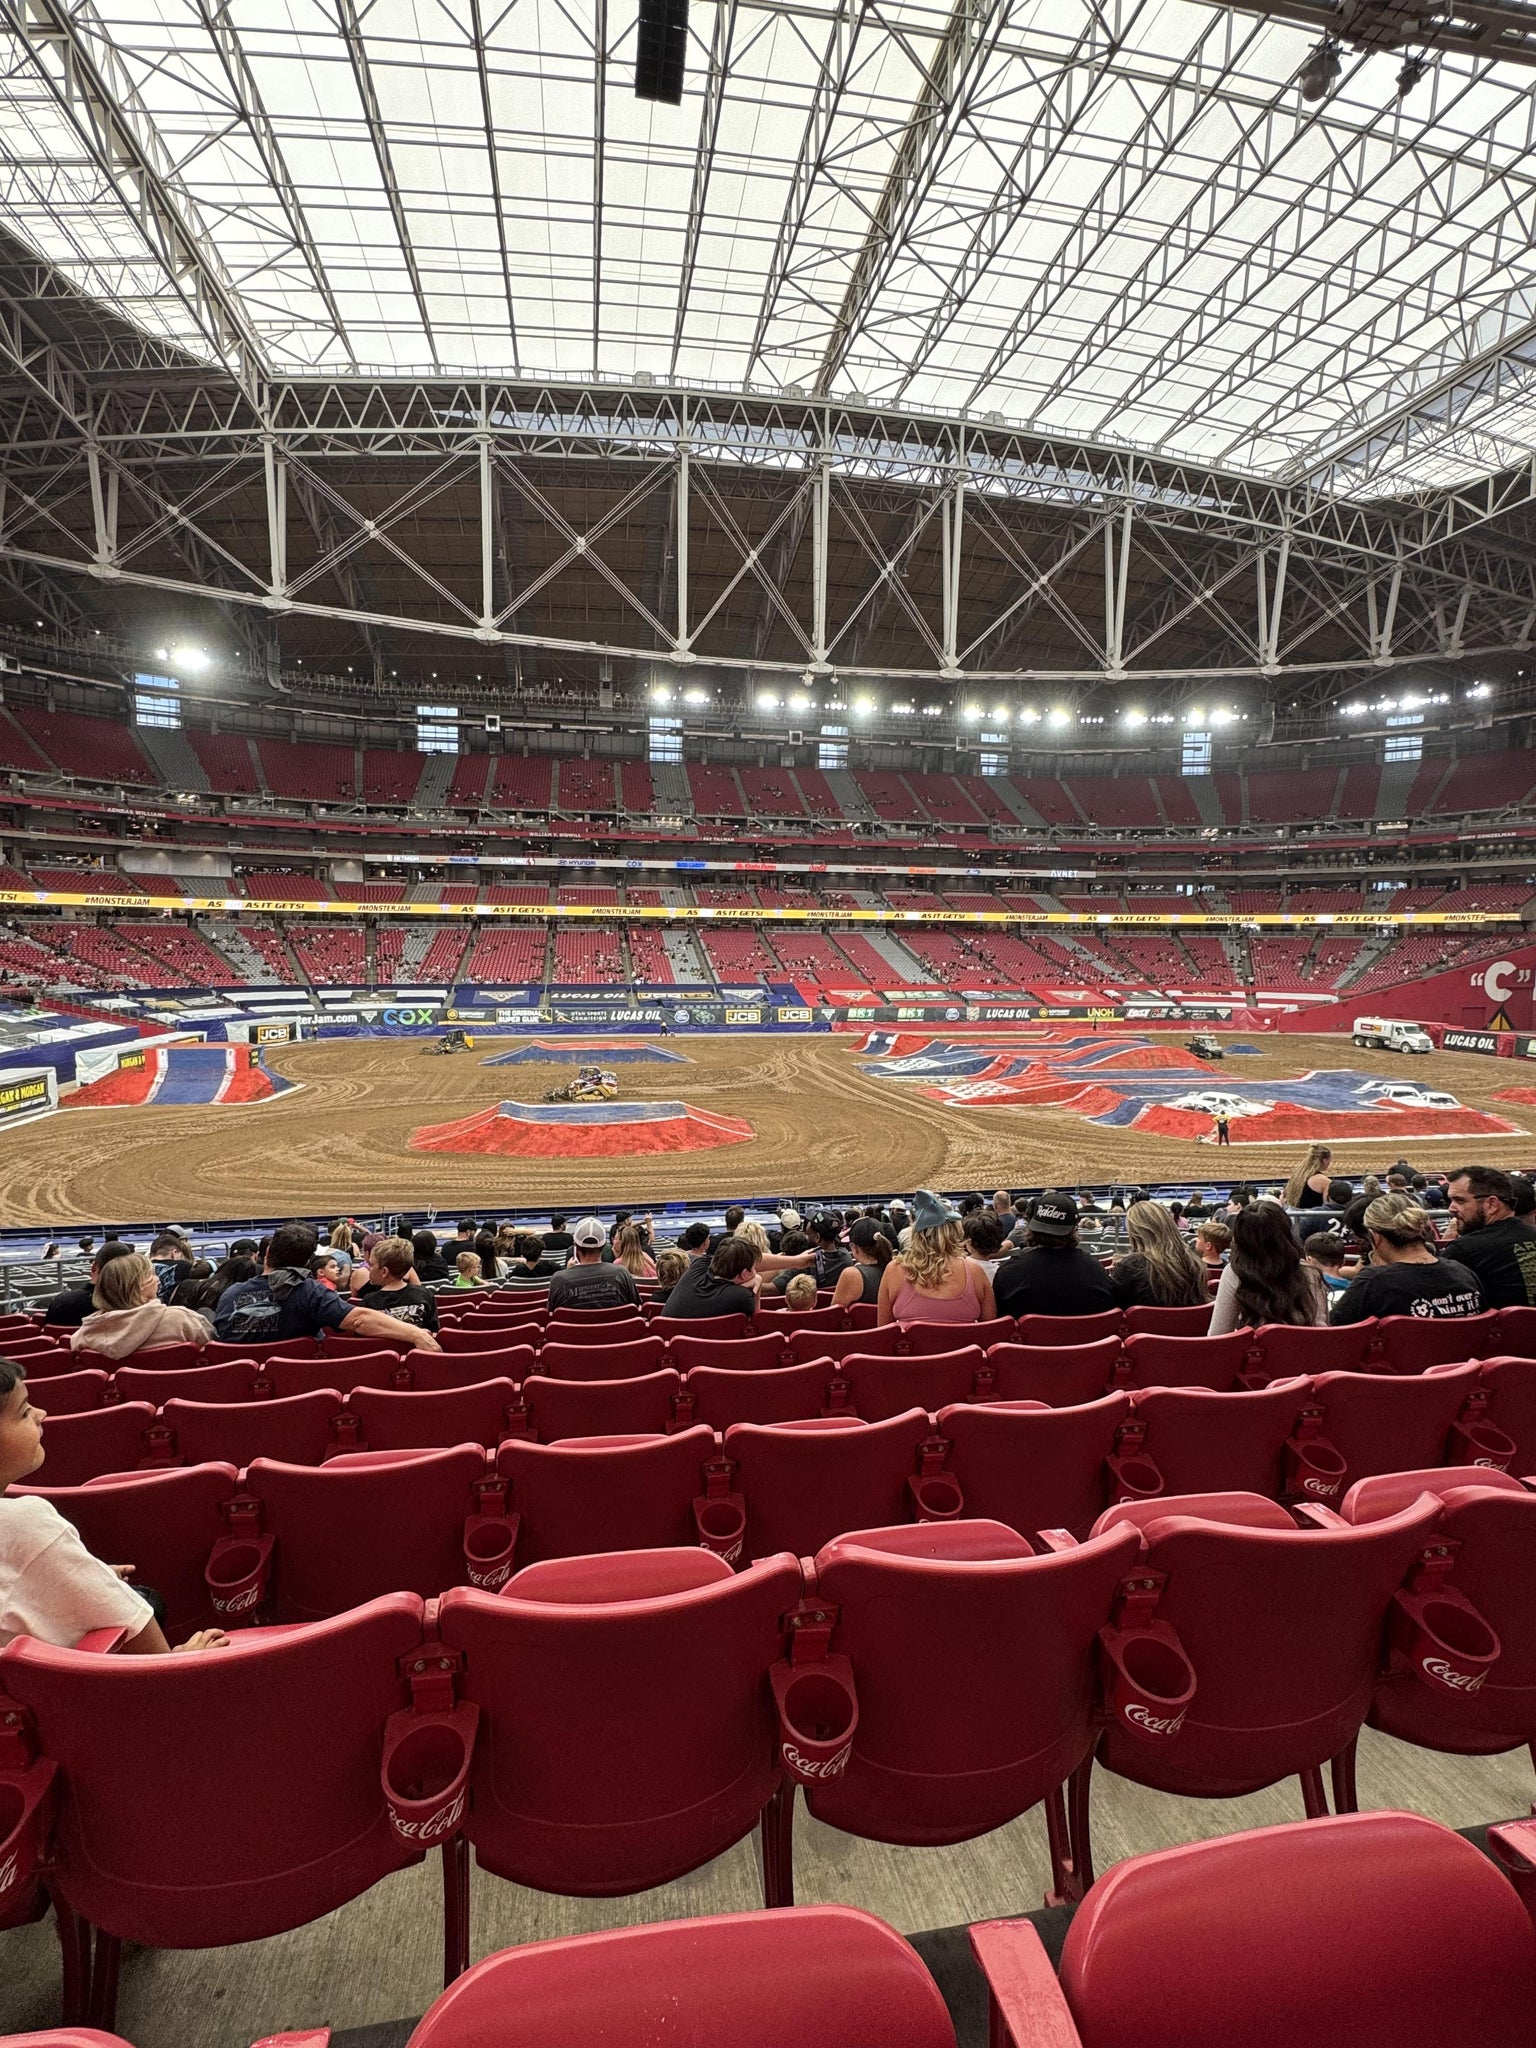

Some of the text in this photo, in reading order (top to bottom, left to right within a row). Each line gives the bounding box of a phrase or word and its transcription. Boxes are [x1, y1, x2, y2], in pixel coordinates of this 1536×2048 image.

[1050, 869, 1079, 878] AVNET
[85, 896, 150, 906] #MONSTERJAM
[383, 1009, 433, 1026] COX
[610, 1010, 662, 1021] LUCAS OIL
[728, 1012, 758, 1021] JCB
[781, 1010, 810, 1019] JCB
[986, 1008, 1031, 1019] LUCAS OIL
[1087, 1007, 1115, 1017] UNOH
[261, 1028, 288, 1041] JCB
[1444, 1034, 1496, 1050] LUCAS OIL
[20, 1082, 45, 1099] MORGAN
